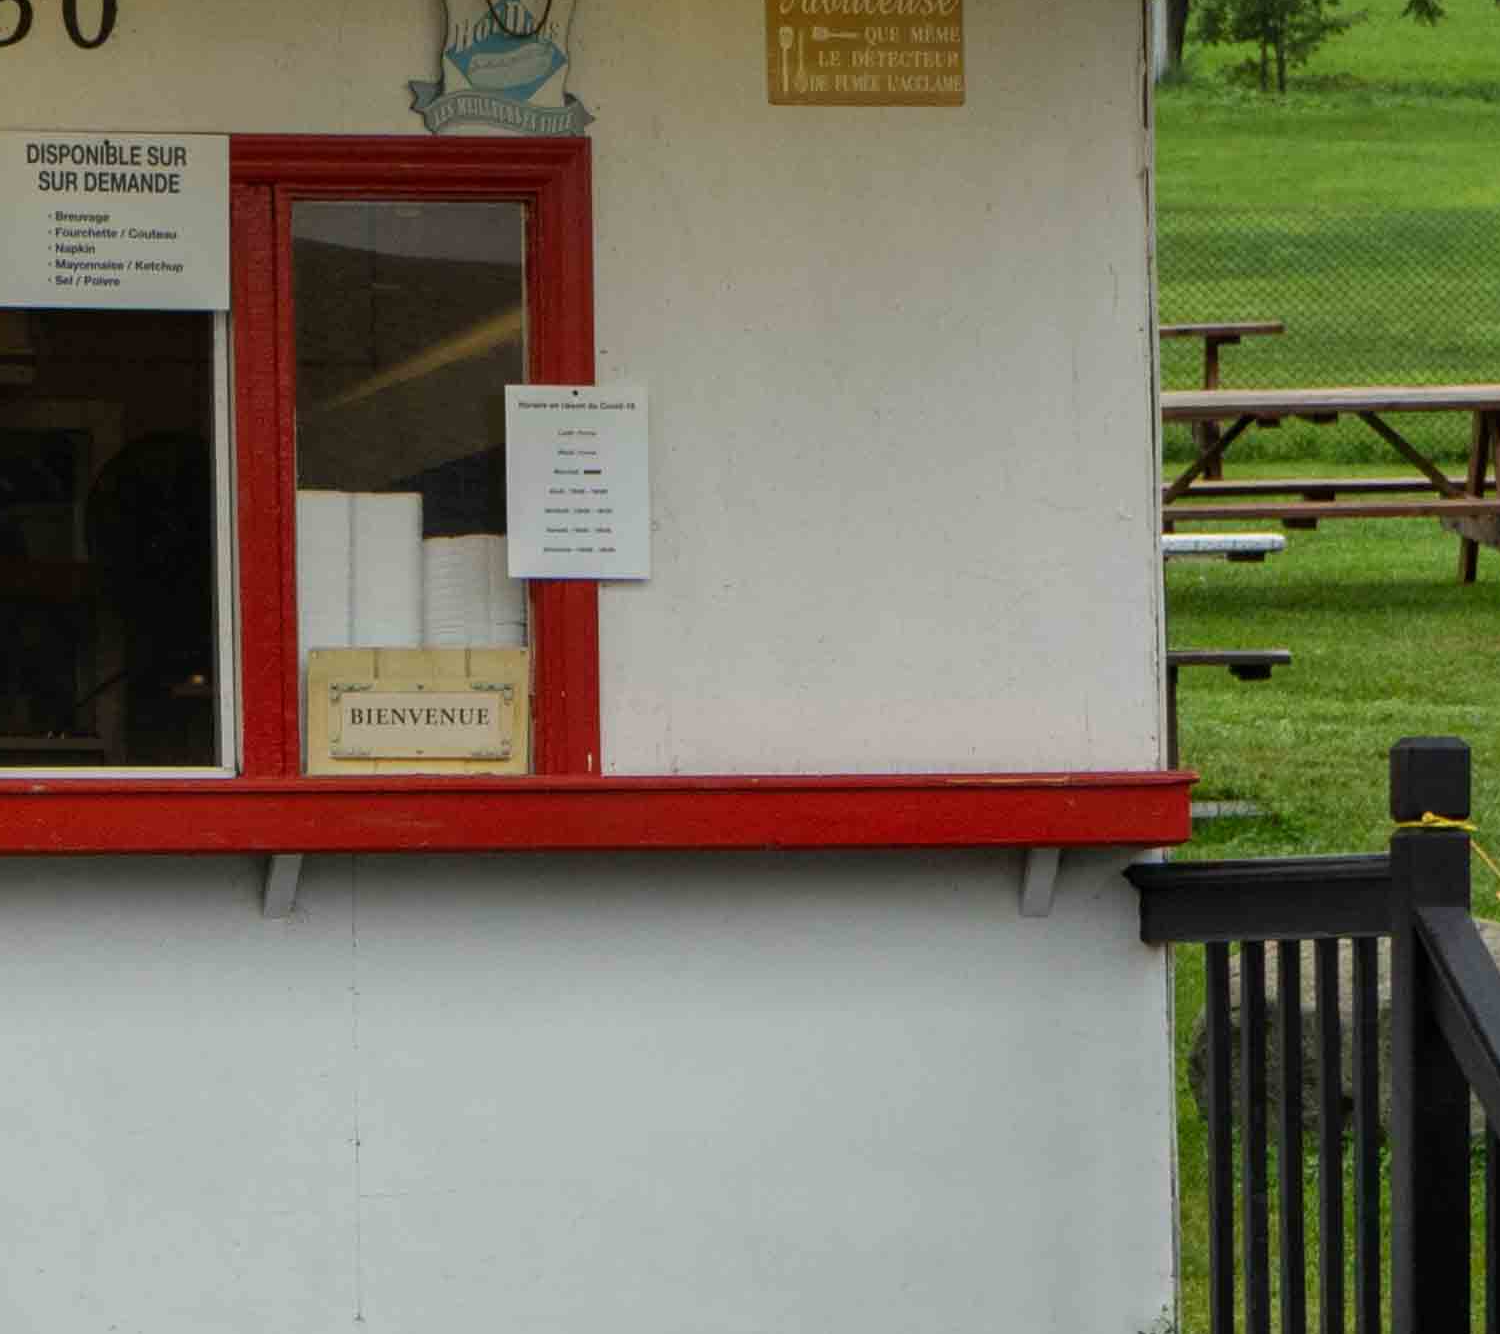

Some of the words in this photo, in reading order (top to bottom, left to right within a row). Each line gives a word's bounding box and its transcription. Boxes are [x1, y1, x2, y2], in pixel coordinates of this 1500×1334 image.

[864, 26, 900, 44] QUE
[818, 50, 841, 67] LE
[26, 143, 142, 166] DISPONIBLE
[147, 145, 188, 167] SUR
[38, 170, 79, 192] SUR
[84, 171, 181, 194] DEMANDE
[55, 210, 110, 224] Breuvage
[55, 227, 118, 239] Fourchette
[127, 228, 177, 240] Couteau
[55, 243, 96, 256] Napkin
[55, 259, 124, 273] Mayonnaise
[134, 260, 184, 274] Ketchup
[55, 275, 73, 286] Sel
[83, 275, 121, 287] Poivre
[351, 707, 489, 726] BIENVENUE
